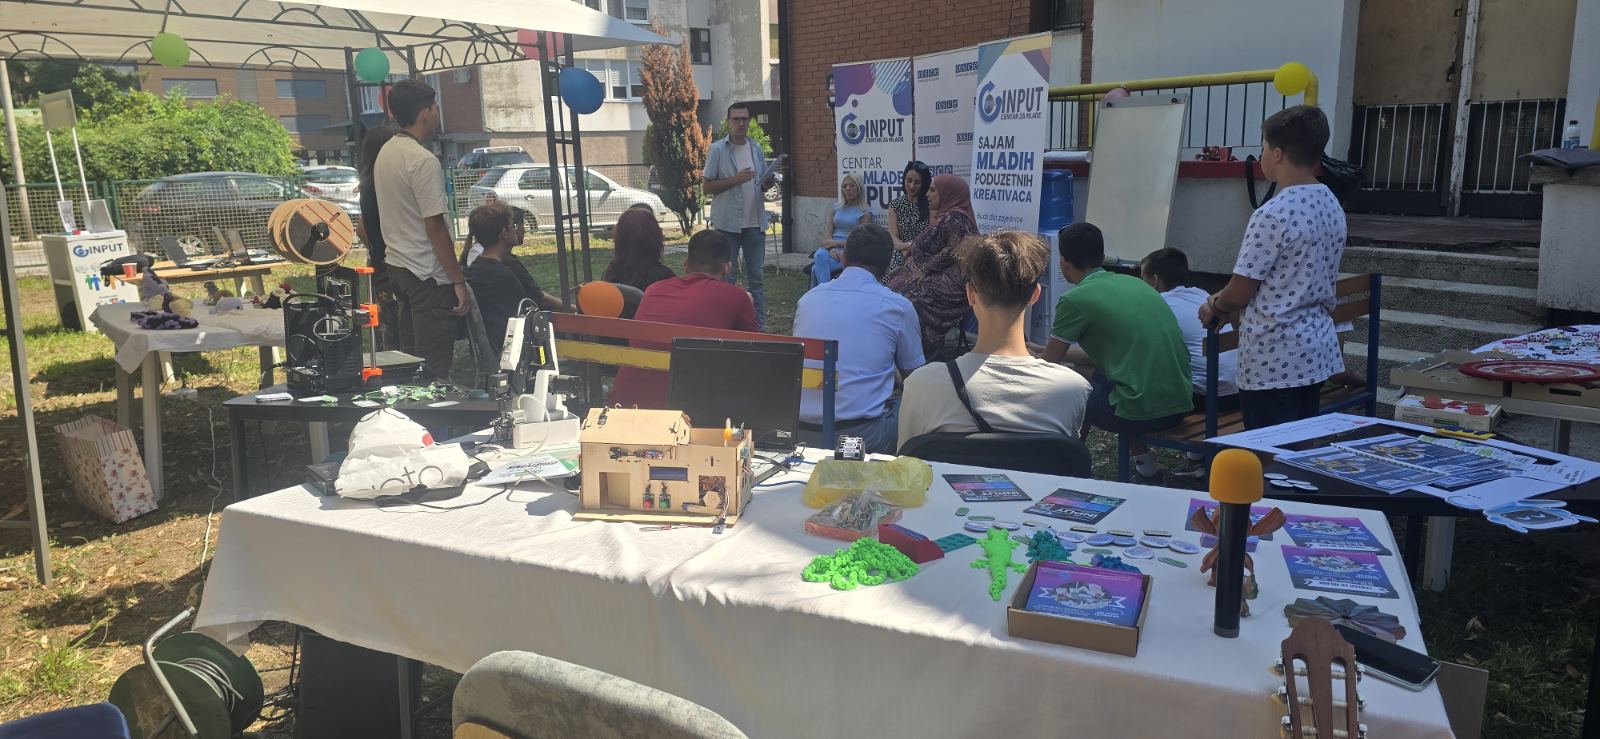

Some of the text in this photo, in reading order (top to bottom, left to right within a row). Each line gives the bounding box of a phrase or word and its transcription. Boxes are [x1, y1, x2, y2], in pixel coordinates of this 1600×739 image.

[1001, 87, 1044, 113] INPUT
[866, 118, 904, 137] INPUT
[979, 136, 1015, 149] SAJAM
[842, 157, 882, 169] CENTAR
[977, 152, 1034, 170] MLADIH
[864, 171, 904, 184] MLADE
[975, 173, 1033, 187] PODUZETNIH
[974, 188, 1032, 202] KREATIVACA
[89, 243, 123, 254] INPUT
